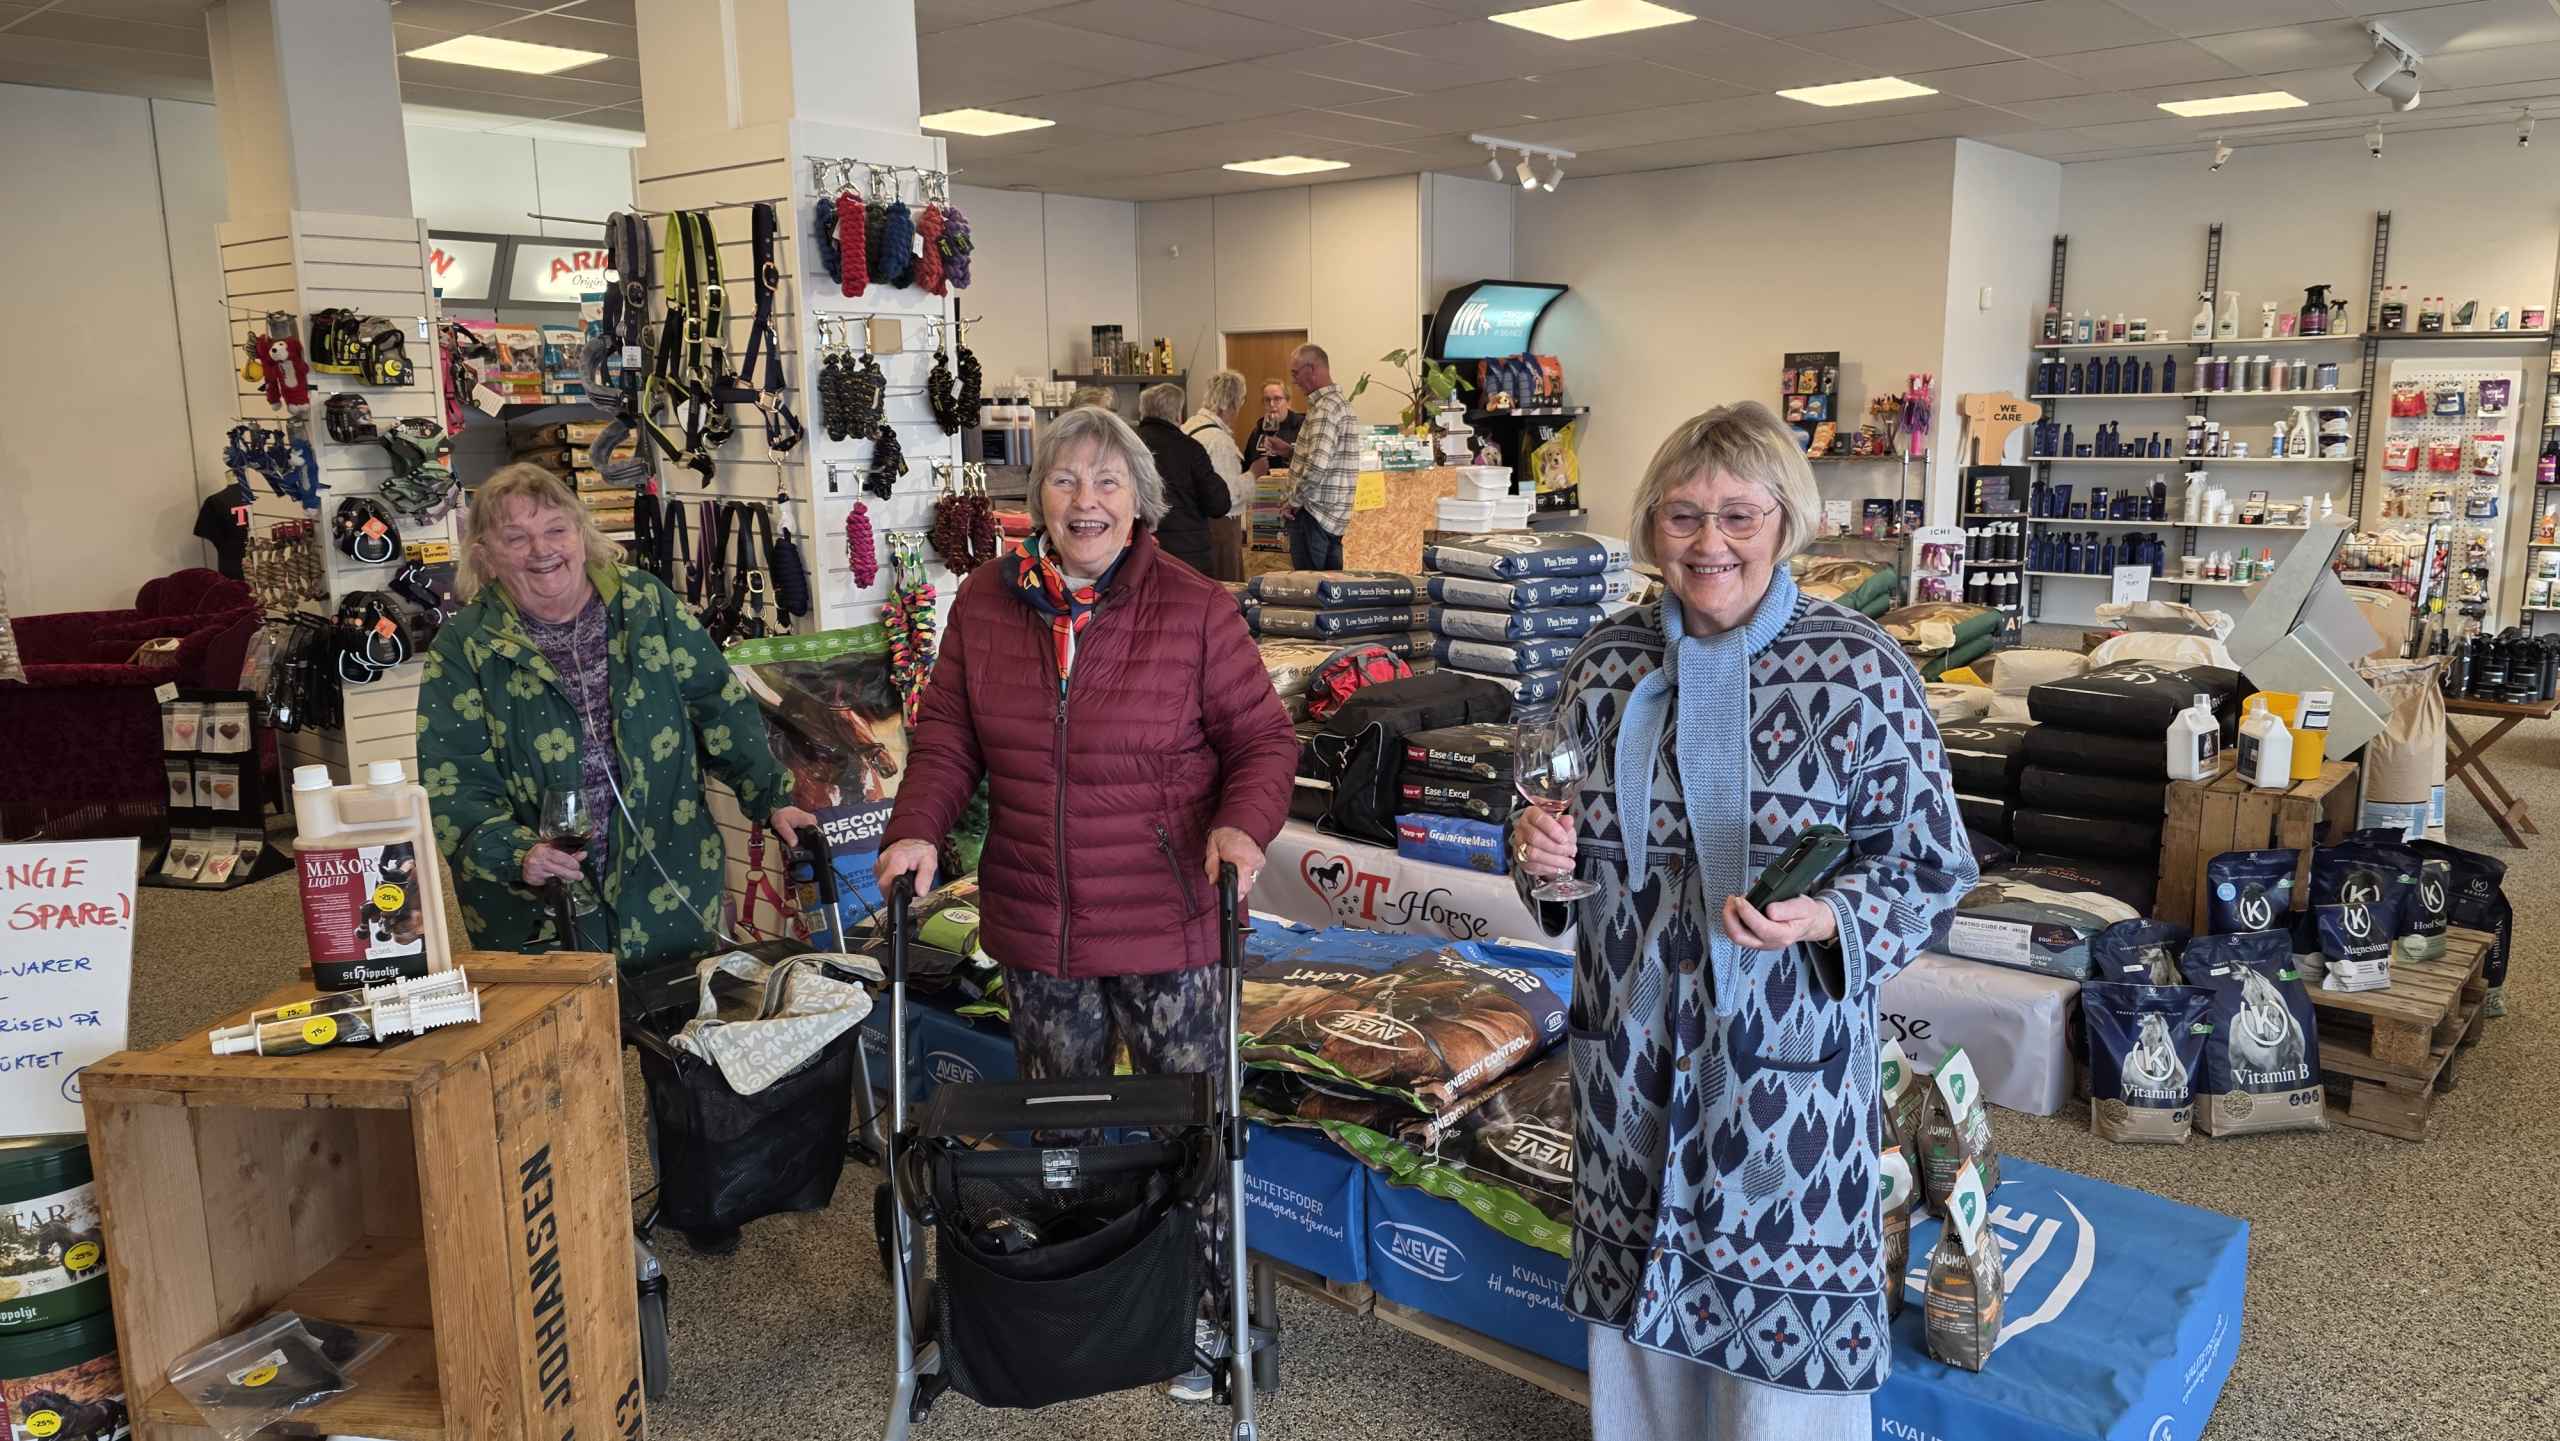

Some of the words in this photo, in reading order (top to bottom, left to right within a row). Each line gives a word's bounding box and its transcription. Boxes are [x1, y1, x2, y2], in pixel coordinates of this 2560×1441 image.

[551, 251, 608, 283] ARI
[1994, 412, 2022, 422] CARE
[2001, 404, 2017, 413] WE
[1544, 558, 1557, 568] Plus
[826, 823, 884, 847] MASH
[1429, 829, 1497, 848] GrainFreeMash
[0, 857, 88, 889] NGE
[308, 875, 349, 889] LIQUID
[8, 892, 131, 930] SPARE!
[1354, 871, 1489, 940] T-Horse
[2344, 943, 2389, 956] Magnesium
[0, 957, 92, 977] -VARER
[1329, 1012, 1407, 1042] AVEVE
[936, 1059, 975, 1084] AVEVE
[1444, 1060, 1484, 1095] ENERGY
[1484, 1034, 1531, 1068] CONTROL
[2233, 1068, 2296, 1086] Vitamin
[2298, 1063, 2310, 1079] B
[2123, 1083, 2180, 1099] Vitamin
[2181, 1084, 2189, 1099] B
[1298, 1209, 1344, 1242] stjerner!
[1391, 1232, 1449, 1272] AVEVE
[519, 1144, 572, 1413] JOHANSEN
[1487, 1273, 1501, 1290] til
